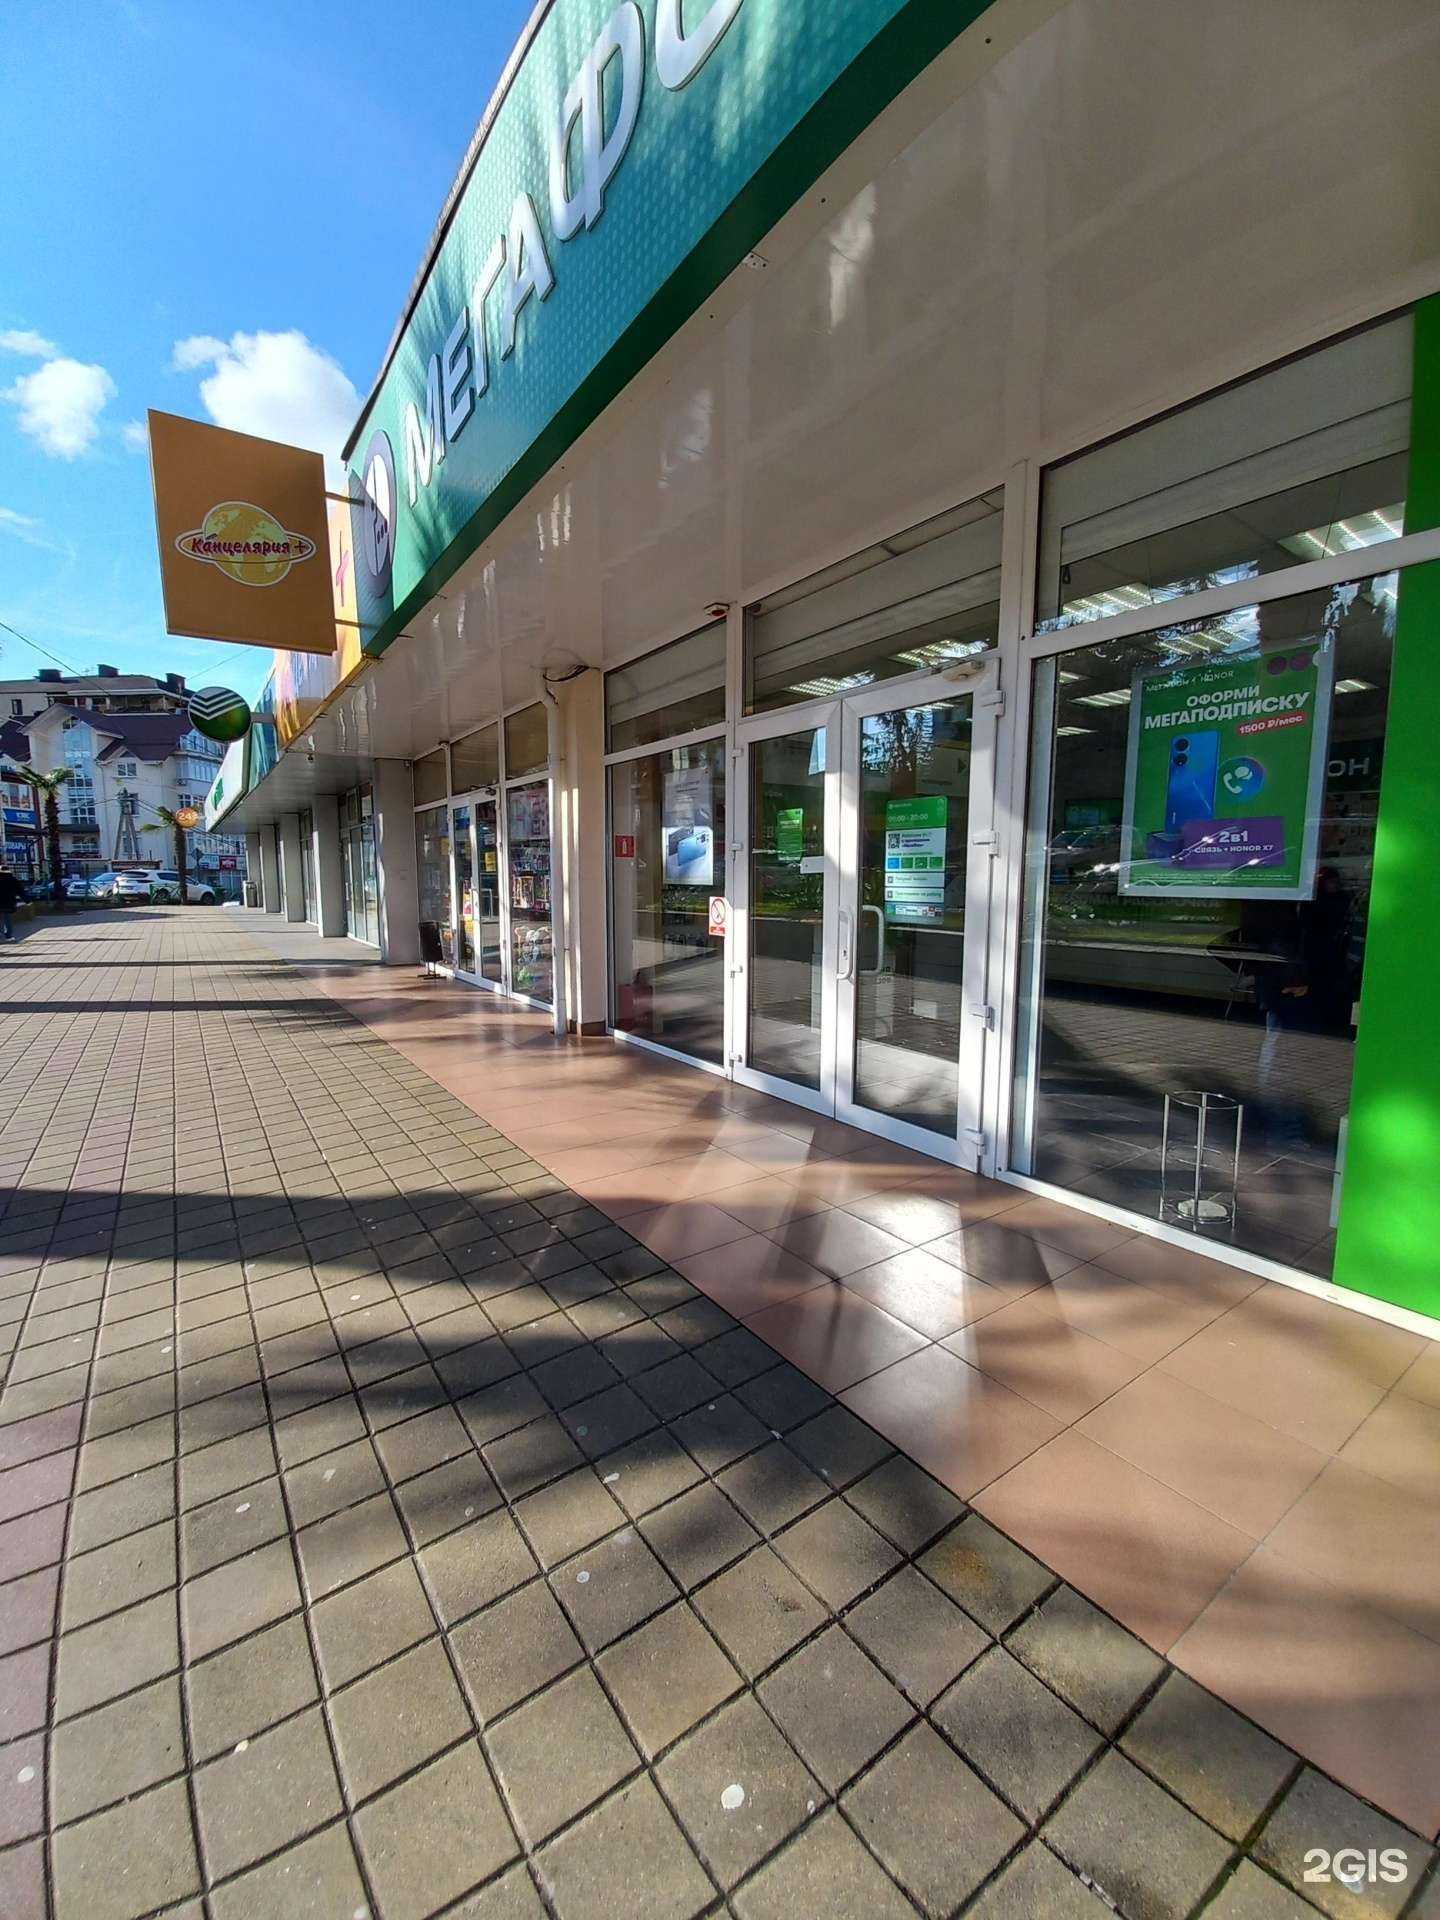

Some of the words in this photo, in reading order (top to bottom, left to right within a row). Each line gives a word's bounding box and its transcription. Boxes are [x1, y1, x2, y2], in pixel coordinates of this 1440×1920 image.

[190, 537, 290, 556] Канцелярия
[1186, 685, 1260, 708] ОФОРМИ
[1144, 691, 1311, 730] МЕГАПОДПИСКУ
[1239, 721, 1266, 735] 1500
[1218, 830, 1249, 844] 2в1
[1230, 844, 1261, 853] HONOR
